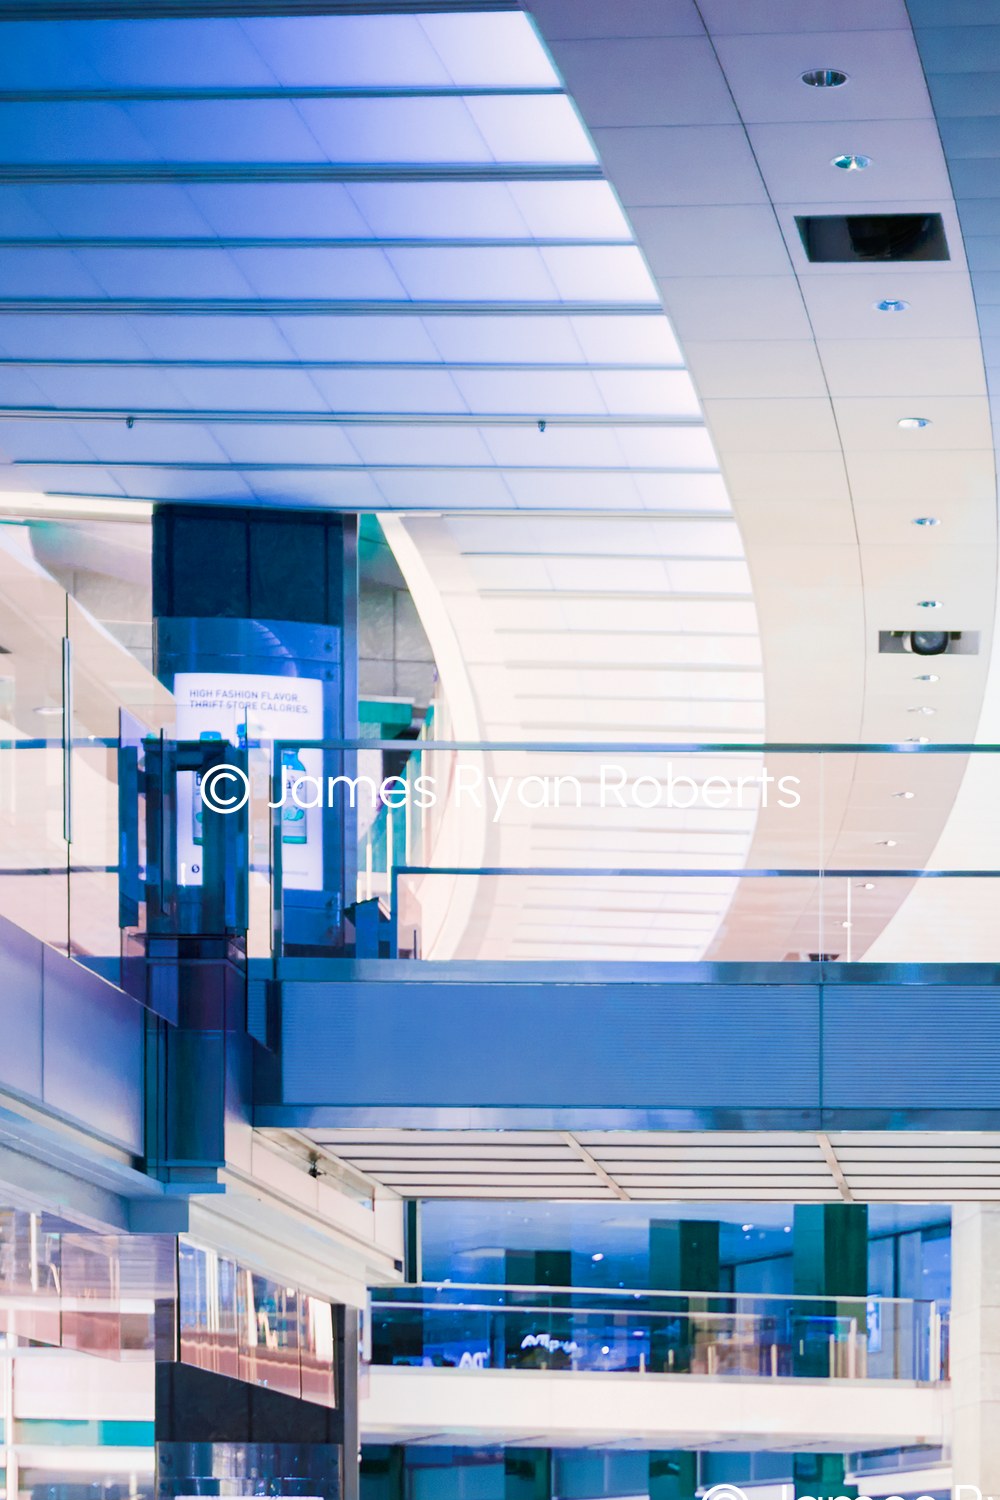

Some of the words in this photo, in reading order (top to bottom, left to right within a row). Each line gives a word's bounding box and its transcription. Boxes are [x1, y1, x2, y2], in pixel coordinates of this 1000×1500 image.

[189, 689, 213, 698] HIGH
[215, 690, 259, 700] FASHION
[190, 699, 224, 708] THRIFT
[226, 701, 258, 710] STORE
